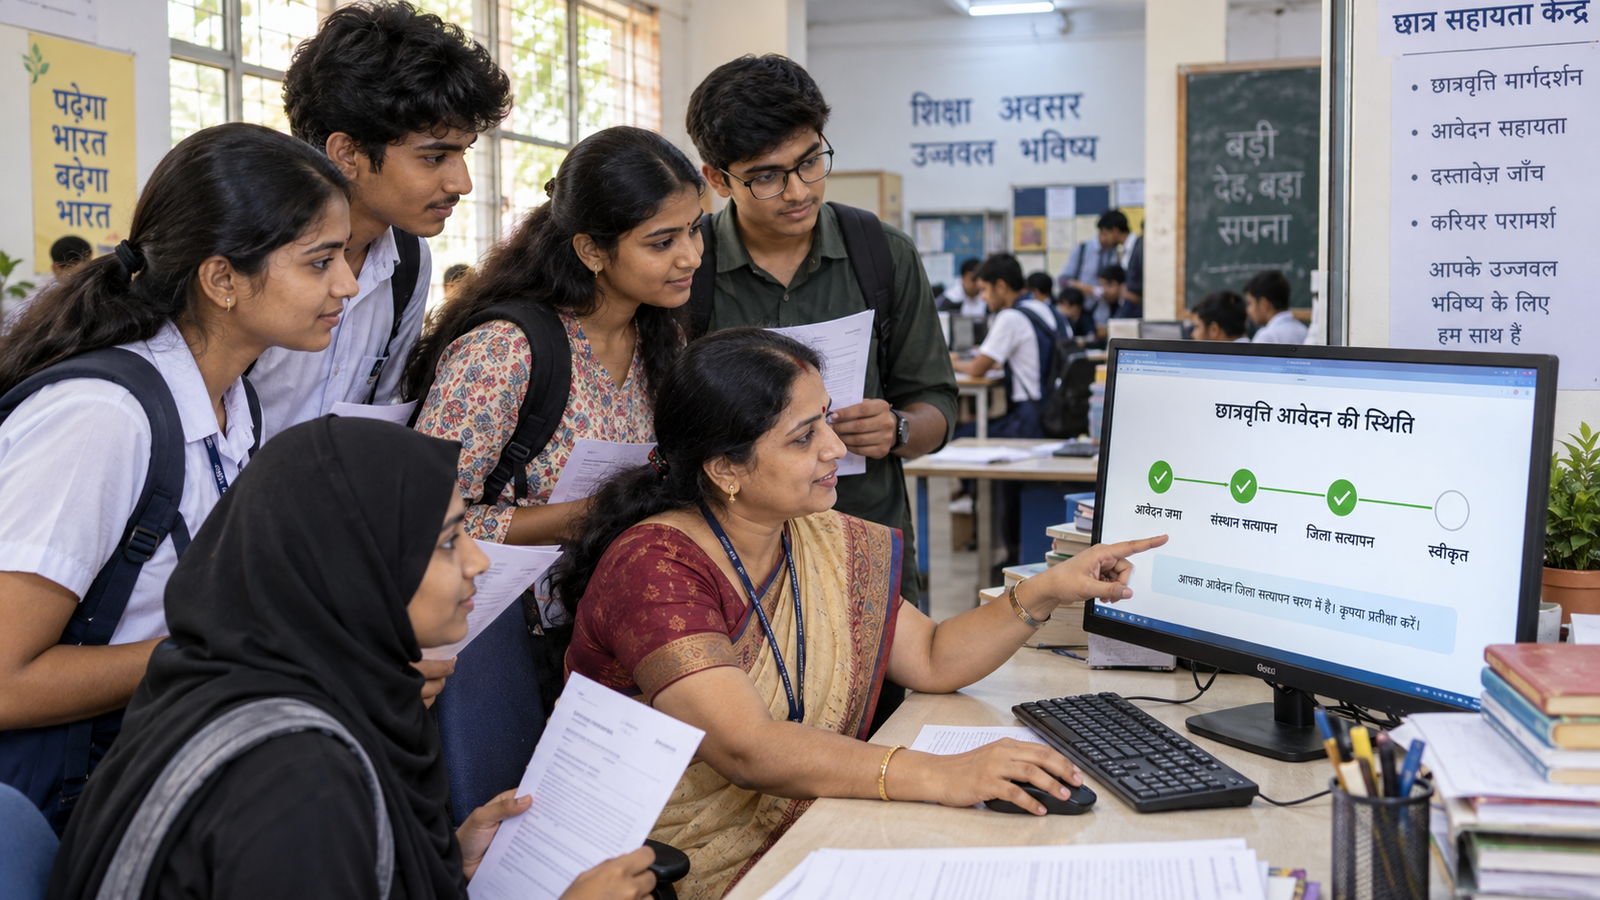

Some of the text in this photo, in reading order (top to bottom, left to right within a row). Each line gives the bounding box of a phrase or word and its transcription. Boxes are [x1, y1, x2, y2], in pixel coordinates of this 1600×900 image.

[1393, 12, 1437, 35] छात्र
[1445, 4, 1533, 32] सहायता
[1431, 65, 1583, 97] छात्रवृत्ति मार्गदर्शन
[52, 83, 106, 124] पढ़ेगा
[910, 91, 1082, 127] शिक्षा अवसर
[52, 125, 107, 156] भारत
[1224, 119, 1279, 166] बड़ी
[1431, 117, 1567, 139] आवेदन सहायता
[1021, 129, 1098, 163] भविष्य
[54, 157, 109, 197] बढ़ेगा
[1258, 171, 1305, 205] बड़ा
[1431, 160, 1545, 185] दस्तावेज़ जाँच
[56, 200, 111, 228] भारत
[1431, 207, 1556, 231] करियर परामर्श
[1217, 214, 1292, 246] सपना
[1430, 256, 1558, 278] आपके उज्जवल
[1432, 291, 1550, 314] भविष्य के लिए
[1438, 323, 1522, 345] हम साथ हैं
[1215, 401, 1414, 434] छात्रवृत्ति आवेदन की स्थिति
[1135, 503, 1182, 520] आवेदन जमा
[1210, 513, 1277, 534] संस्थान सत्यापन
[1306, 525, 1374, 549] जिला सत्यापन
[1428, 543, 1469, 565] स्वीकृत
[1178, 574, 1204, 587] आपका
[1206, 578, 1232, 593] आवेदन
[1235, 582, 1255, 598] जिला
[1258, 590, 1290, 604] सत्यापन
[1293, 597, 1312, 608] चरण
[1315, 597, 1323, 611] में
[1340, 605, 1365, 620] कृपया
[1368, 610, 1397, 626] प्रतीक्षा
[1400, 615, 1420, 631] करें।
